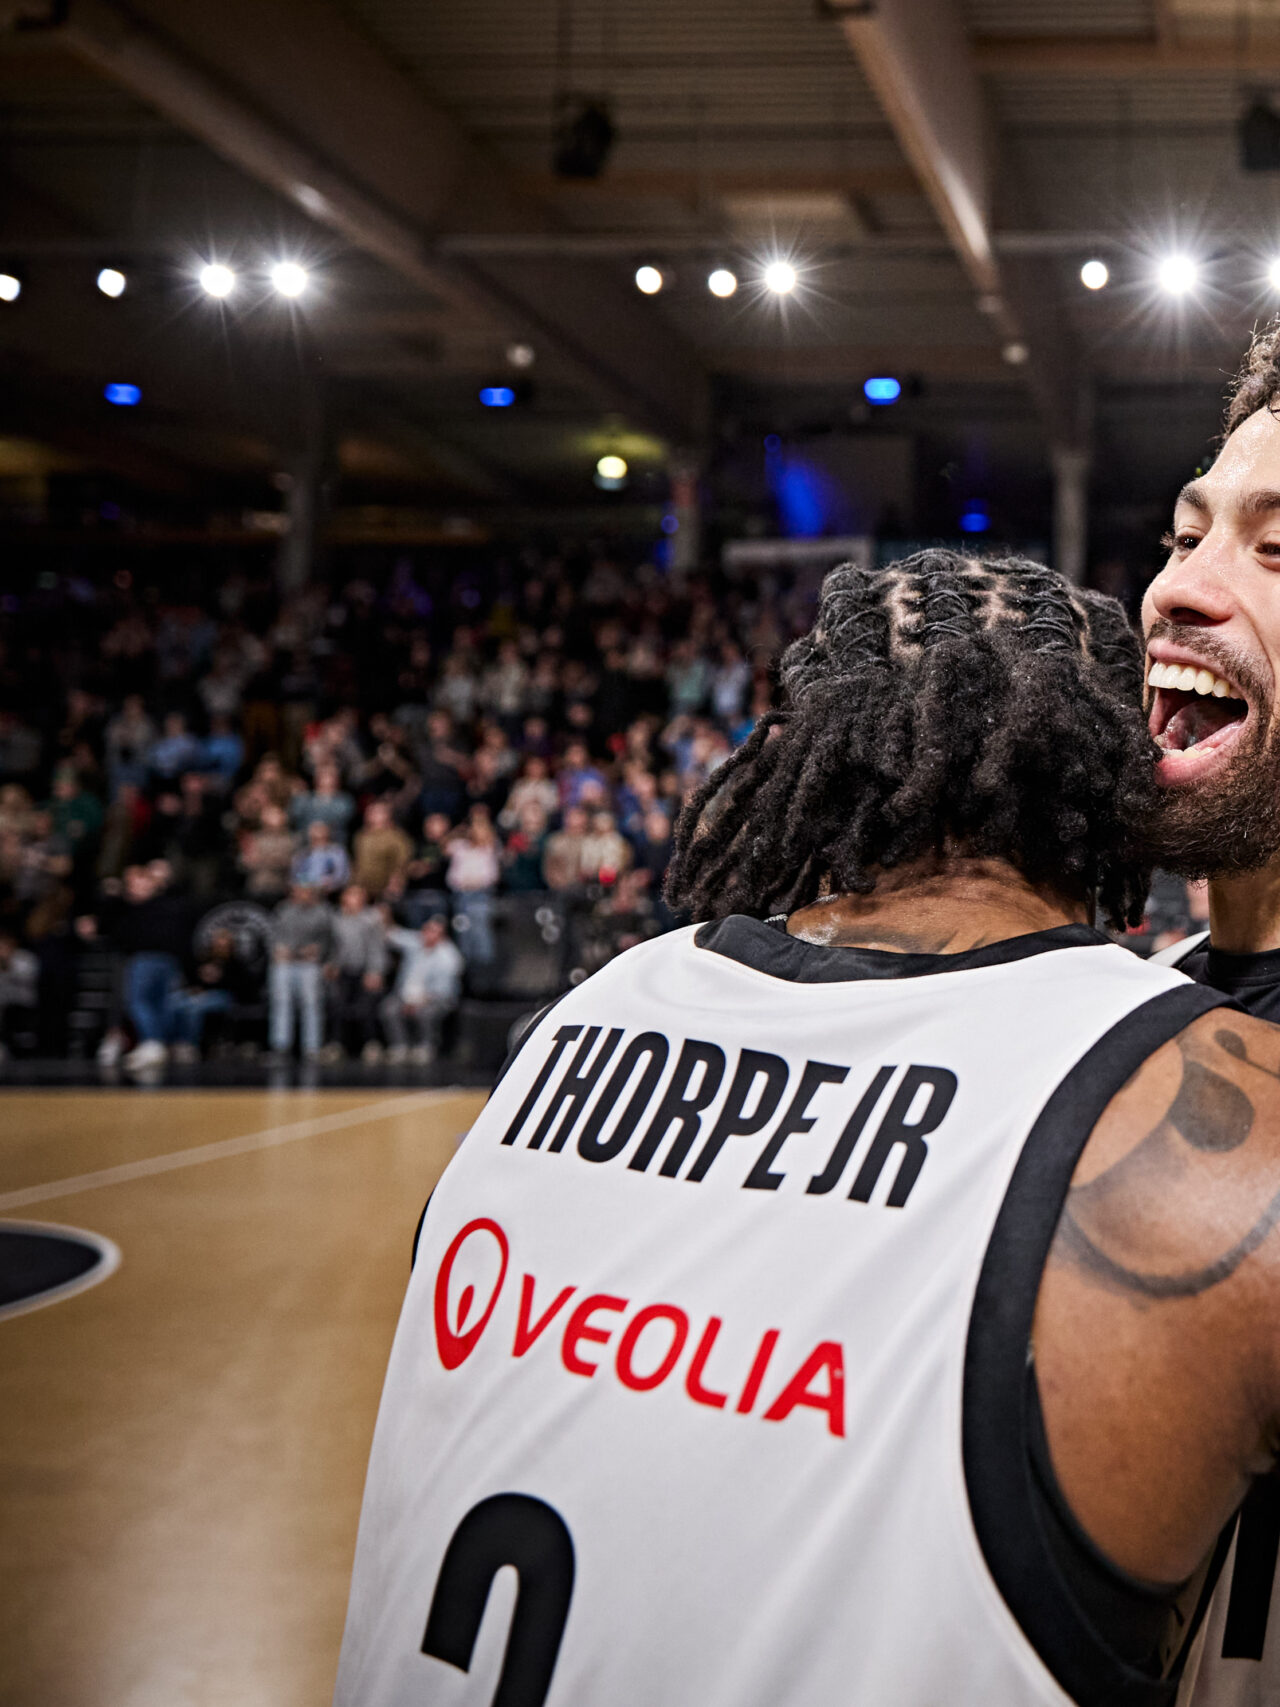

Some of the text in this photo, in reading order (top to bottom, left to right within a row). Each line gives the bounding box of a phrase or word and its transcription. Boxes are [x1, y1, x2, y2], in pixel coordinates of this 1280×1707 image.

[500, 1024, 959, 1209] THORPE JR
[511, 1272, 848, 1440] VEOLIA
